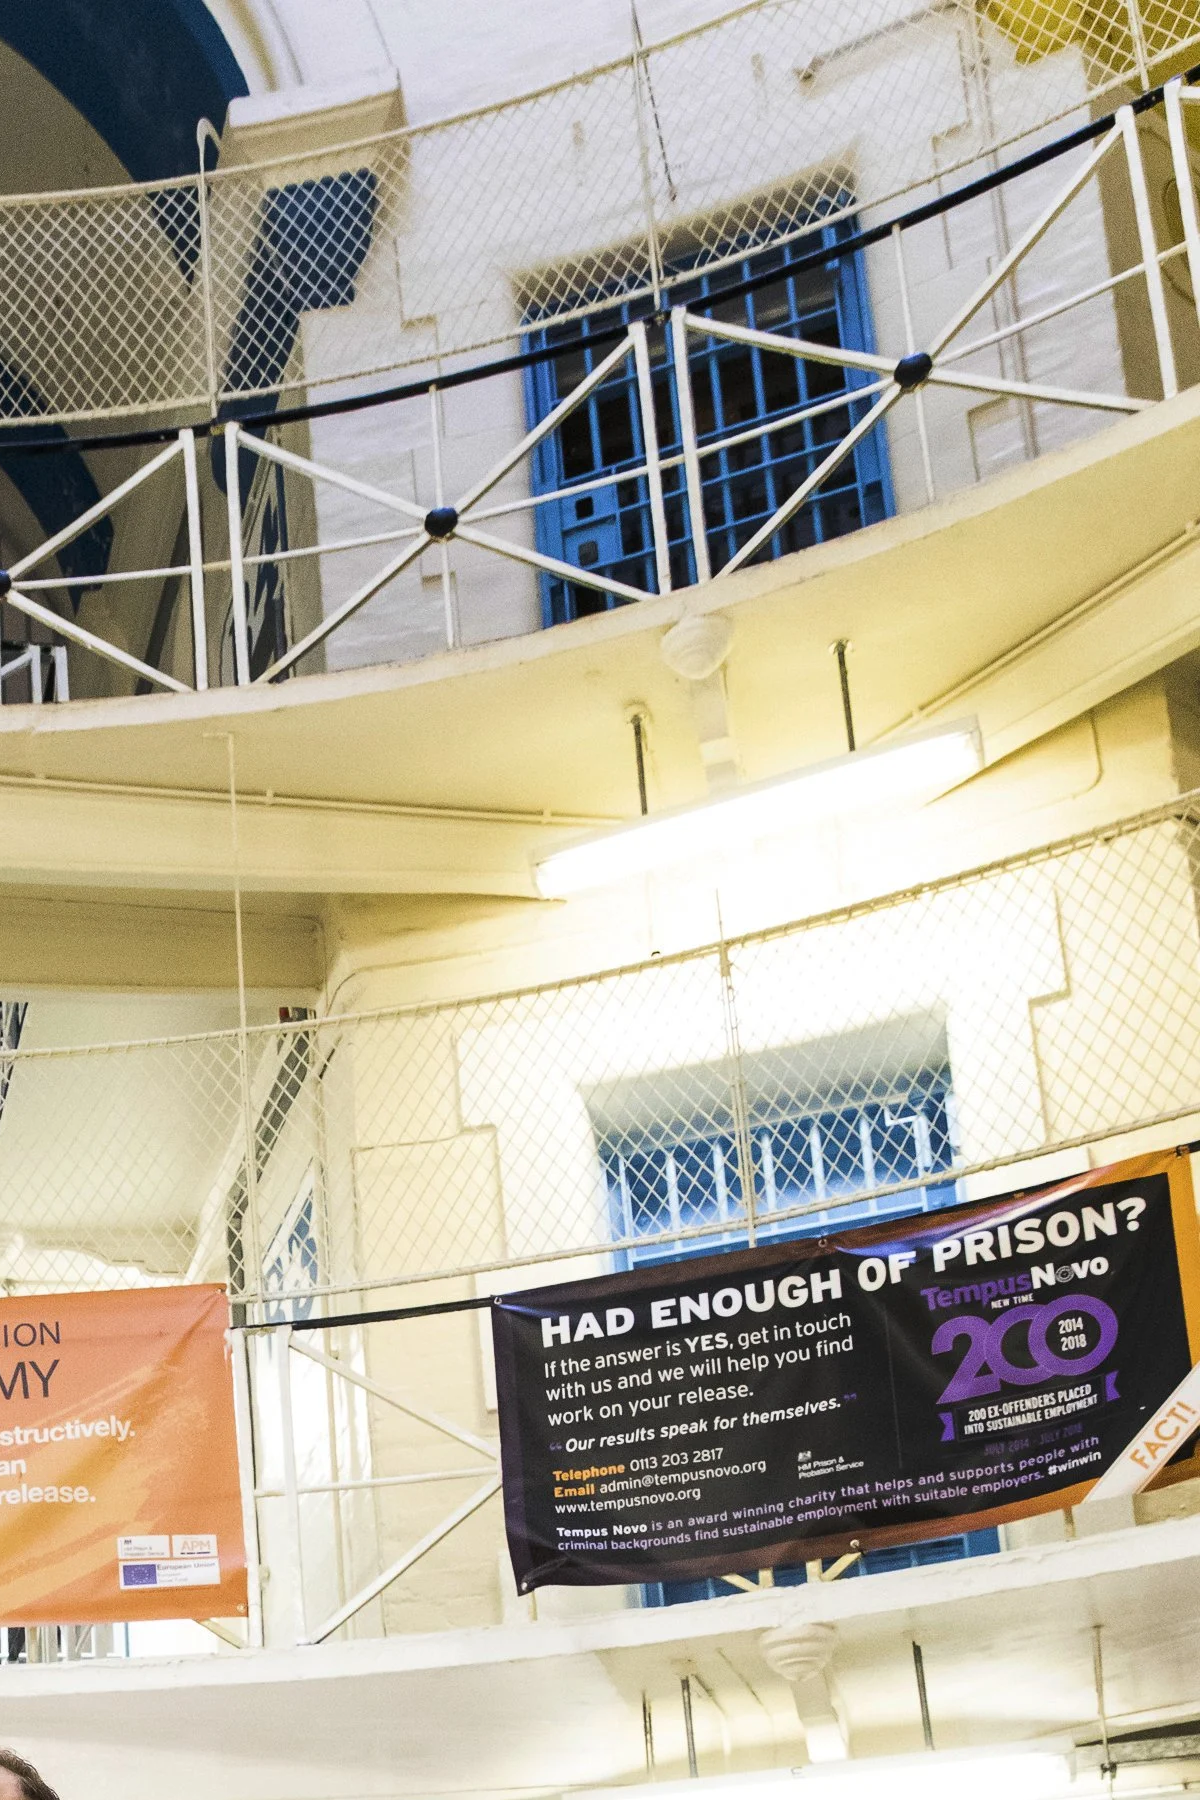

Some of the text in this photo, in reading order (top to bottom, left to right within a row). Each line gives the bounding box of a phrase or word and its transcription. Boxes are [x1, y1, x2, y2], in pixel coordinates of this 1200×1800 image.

[541, 1197, 1147, 1348] HAD ENOUGH OF PRISON?
[991, 1293, 1034, 1310] NEW TIME
[544, 1312, 851, 1378] If the answer is YES, get in touch
[1058, 1316, 1083, 1334] 2014
[1060, 1333, 1087, 1352] 2018
[546, 1334, 854, 1401] with us and we will help you find
[932, 1294, 1118, 1405] 200
[548, 1383, 754, 1427] work on your release.
[964, 1394, 1098, 1435] INTO SUSTAINABLE EMPLOYMENT
[968, 1384, 1092, 1422] 200 EX-OFFENDERS PLACED
[600, 1428, 655, 1448] results
[660, 1418, 708, 1440] speak
[714, 1416, 736, 1432] for
[1128, 1402, 1199, 1470] FACT!
[553, 1447, 724, 1483] Telephone 0113 203 2817
[554, 1459, 766, 1499] Email admin@tempusnovo.org
[555, 1488, 701, 1514] www.tempusnovo.org
[556, 1436, 1100, 1539] Tempus Novo is an award winning charity that helps and supports people with
[558, 1450, 1102, 1551] criminal backgrounds find sustainable employment with suitable employers. #winwin
